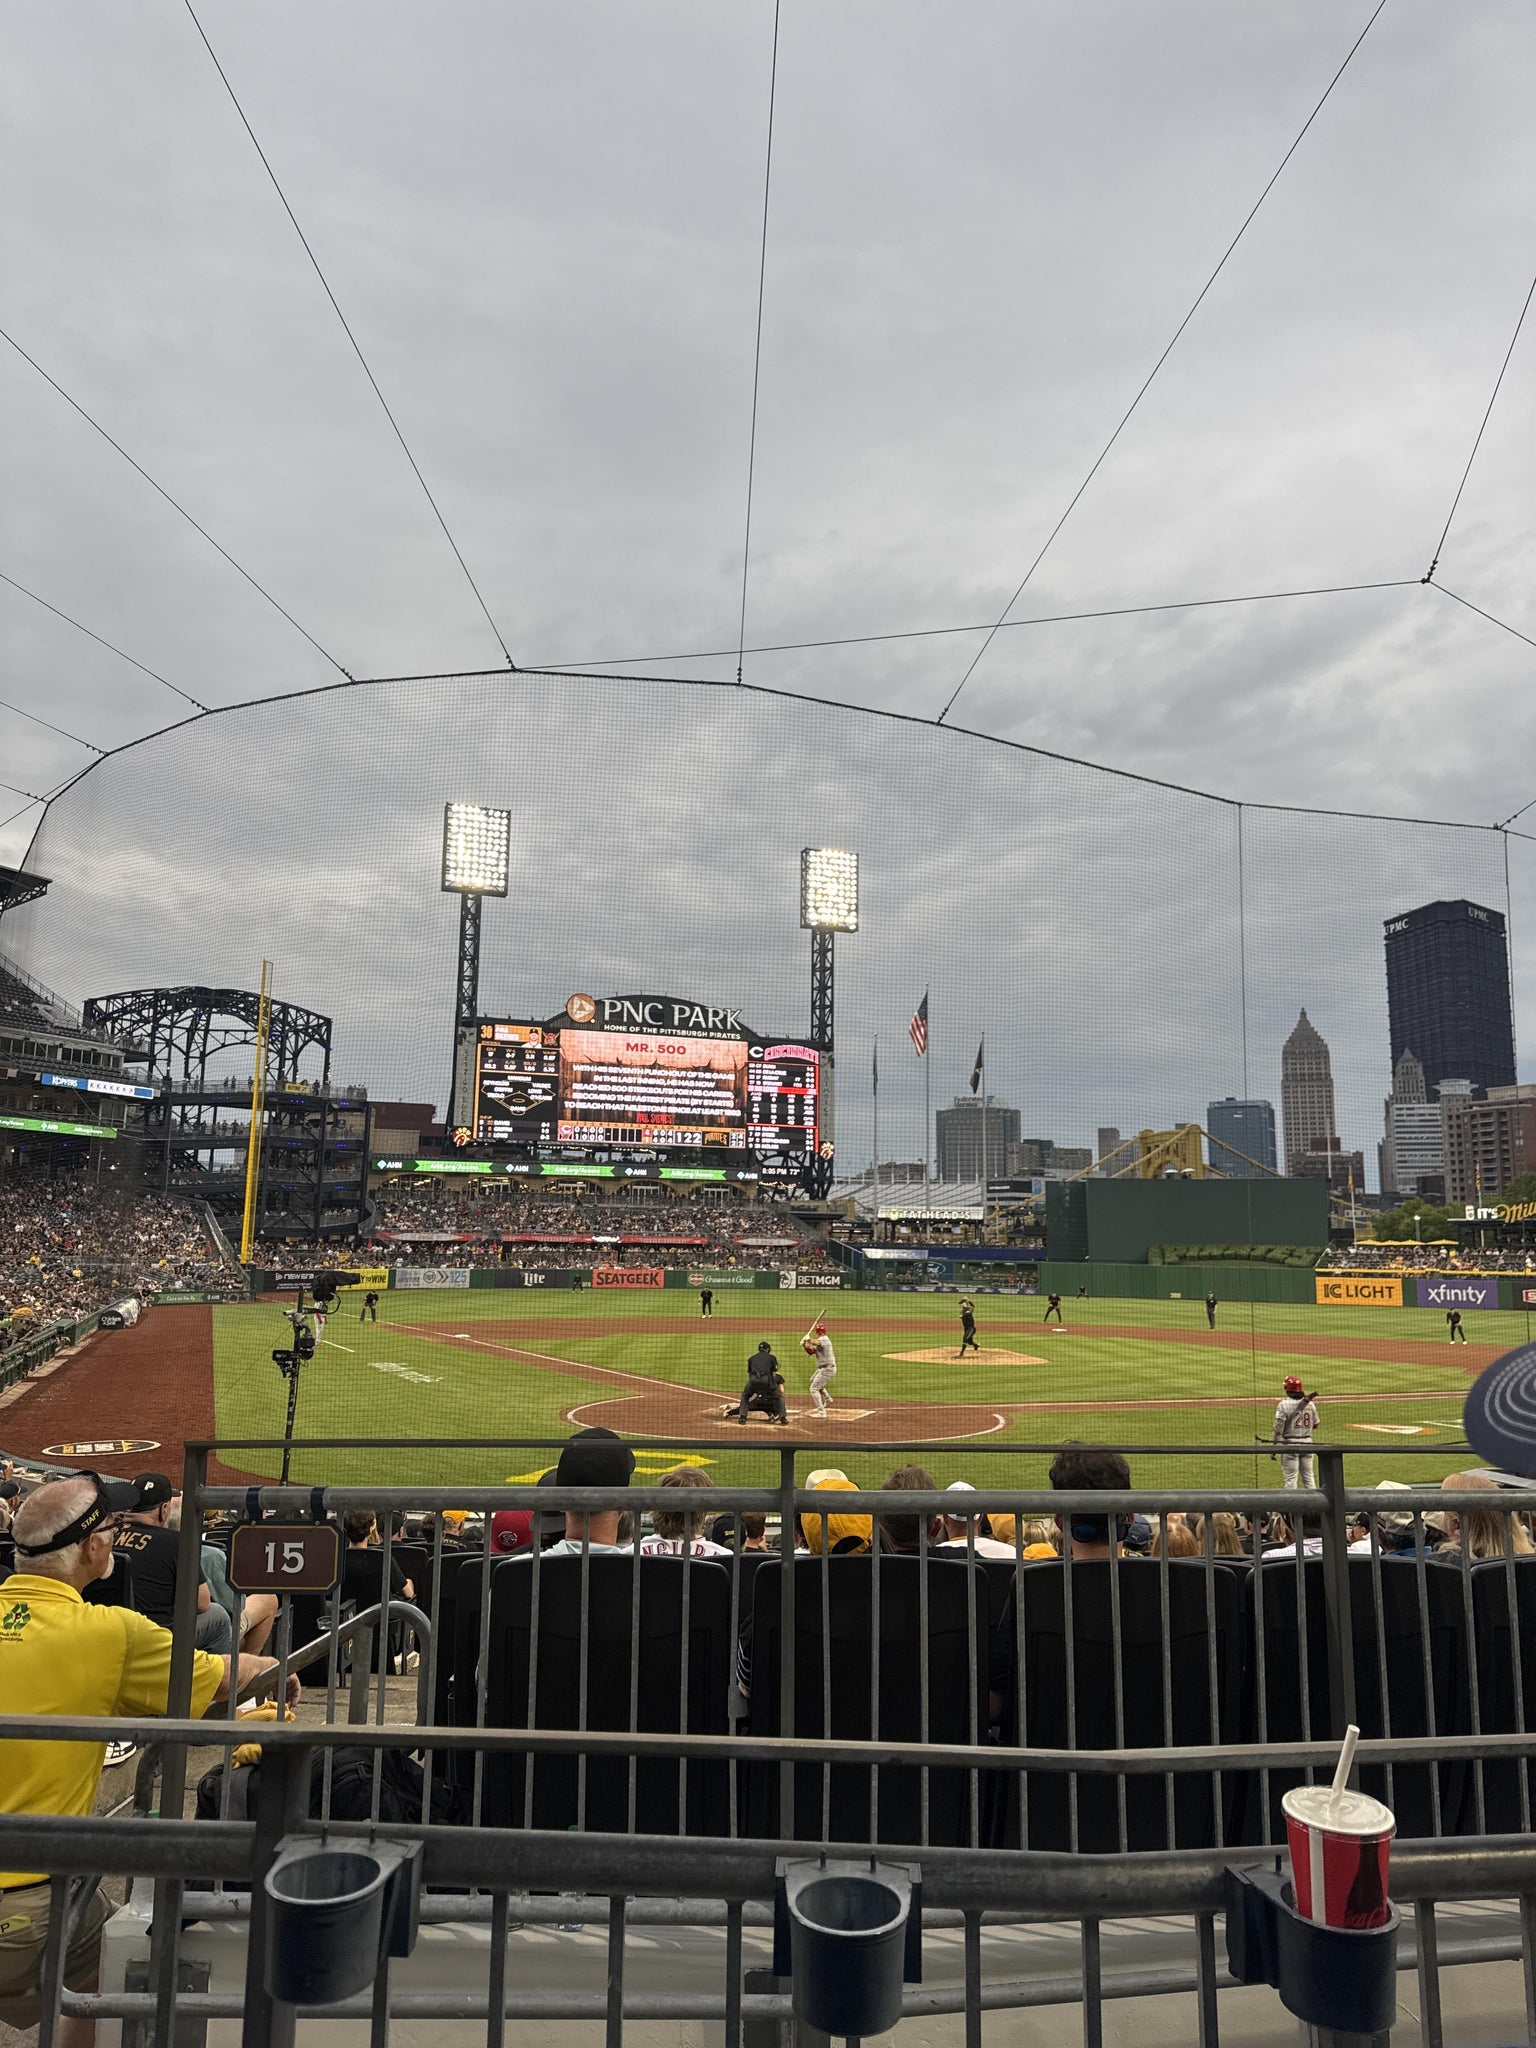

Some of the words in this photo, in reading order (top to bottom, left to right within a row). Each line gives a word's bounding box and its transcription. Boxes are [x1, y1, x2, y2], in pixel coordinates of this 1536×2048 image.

[1468, 906, 1489, 923] UPMC
[1385, 918, 1409, 935] UPMC
[600, 999, 664, 1025] PNC
[671, 1004, 742, 1031] PARK
[481, 1025, 493, 1039] 30
[604, 1024, 627, 1032] HOME
[659, 1028, 708, 1038] PITTSBURGH
[709, 1031, 741, 1040] PIRATES
[626, 1042, 654, 1053] MR.
[657, 1044, 687, 1055] 500
[608, 1066, 643, 1075] SEVENTH
[645, 1068, 687, 1078] PUNCHOUT
[572, 1083, 611, 1091] REACHED
[628, 1086, 674, 1095] STRIKEOUTS
[572, 1092, 616, 1101] BECOMING
[677, 1132, 682, 1143] 1
[684, 1132, 692, 1143] 2
[692, 1133, 701, 1143] 2
[386, 1161, 403, 1169] AHN
[632, 1168, 647, 1176] AHN
[903, 1211, 923, 1219] FAT
[1477, 1207, 1498, 1219] IT'S
[371, 1274, 386, 1284] WIN!
[450, 1270, 467, 1284] 125
[523, 1271, 546, 1287] Lite
[596, 1271, 660, 1286] SEATGEEK
[736, 1275, 753, 1284] Good
[797, 1275, 840, 1285] BETMGM
[1323, 1283, 1342, 1299] IC
[1345, 1284, 1395, 1299] LIGHT
[1427, 1284, 1487, 1304] xfinity
[1295, 1412, 1310, 1428] 28
[144, 1481, 154, 1491] P
[81, 1508, 100, 1530] STAFF
[114, 1531, 152, 1551] NES
[265, 1541, 305, 1574] 15
